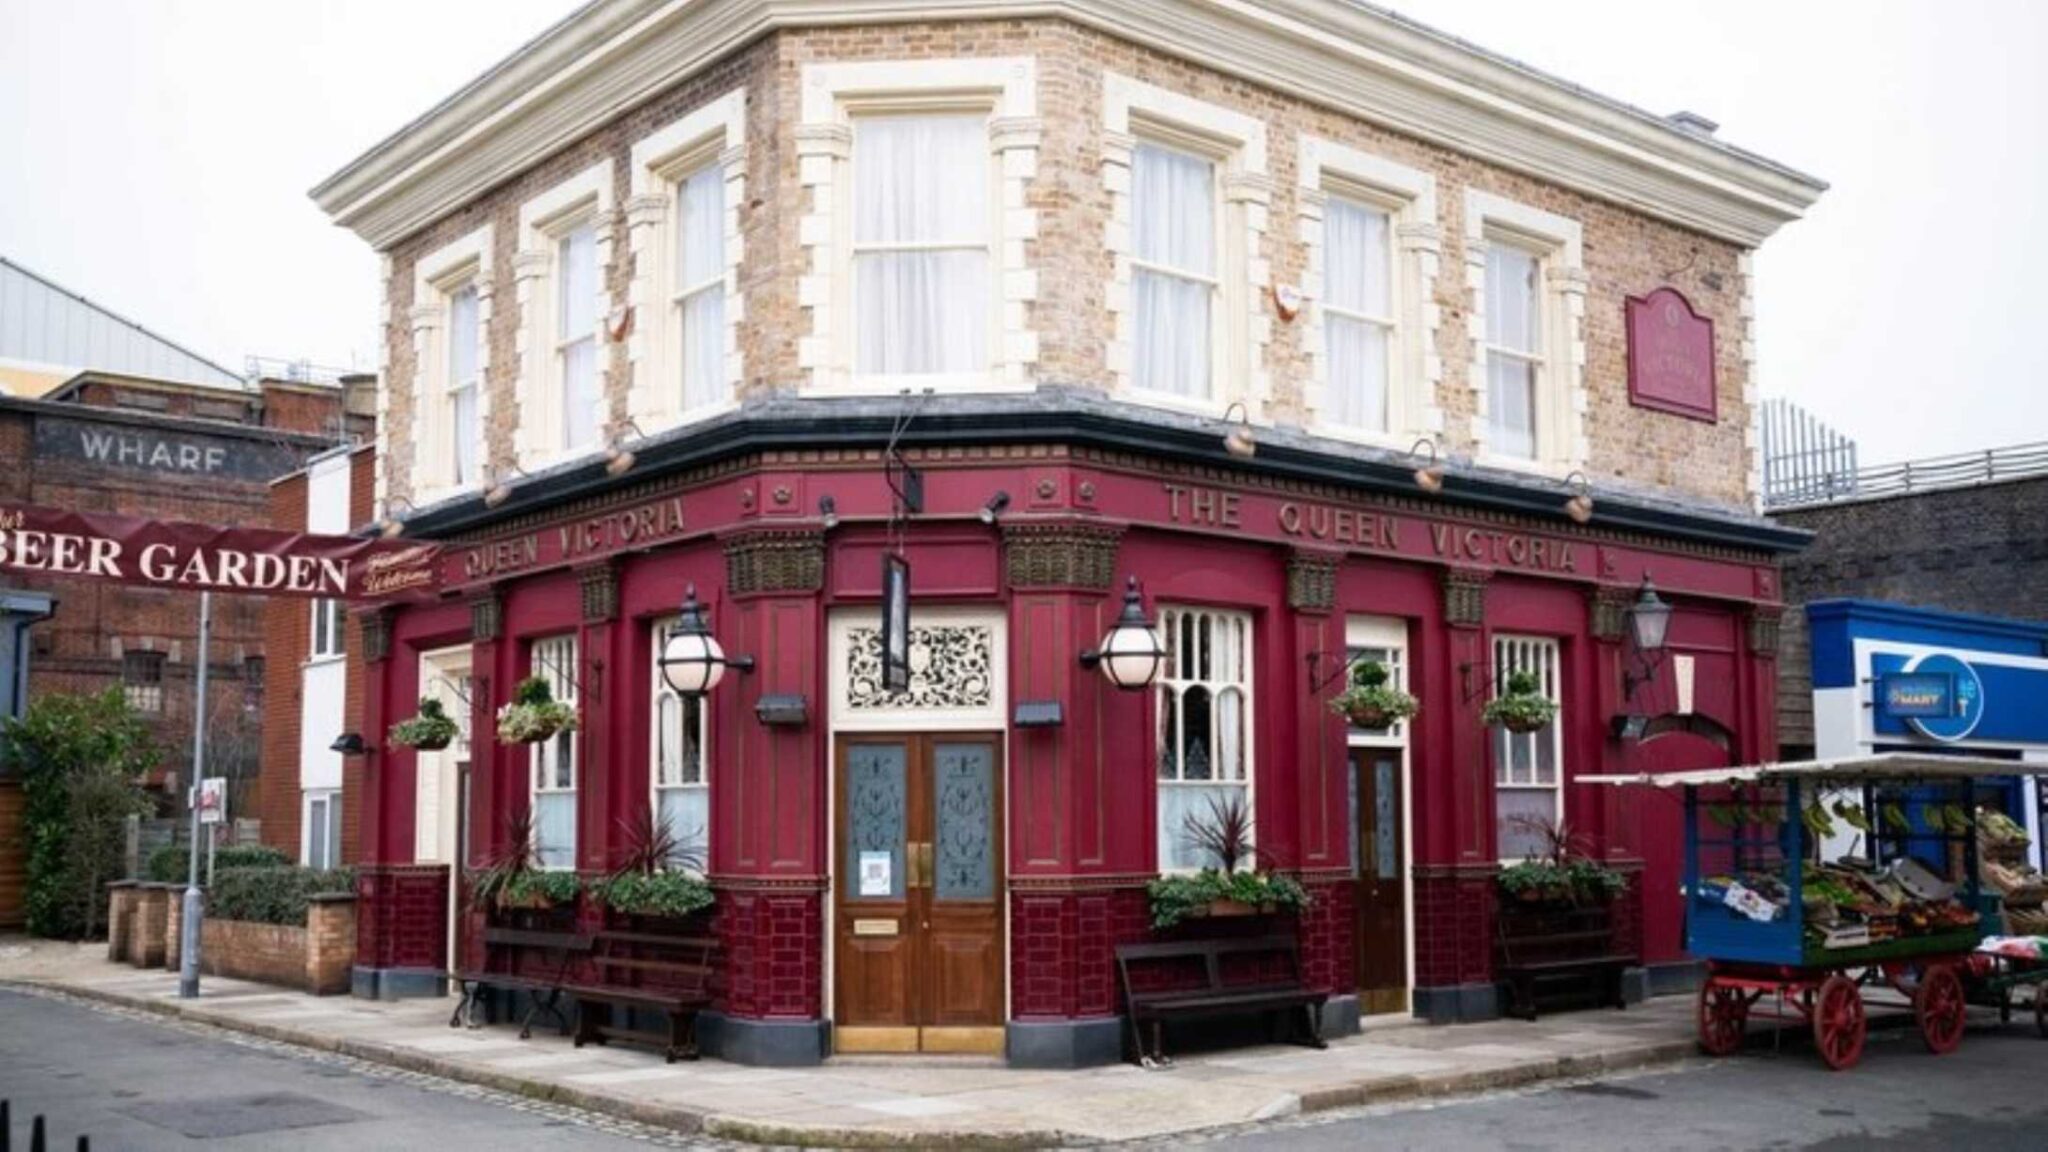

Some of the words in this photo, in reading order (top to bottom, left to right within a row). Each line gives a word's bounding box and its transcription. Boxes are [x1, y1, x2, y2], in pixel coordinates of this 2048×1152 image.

[80, 431, 226, 471] WHARF
[464, 533, 538, 578] QUEEN
[559, 498, 684, 557] VICTORIA
[1165, 483, 1242, 528] THE
[1278, 502, 1398, 548] QUEEN
[1430, 522, 1576, 573] VICTORIA
[139, 543, 350, 593] GARDEN
